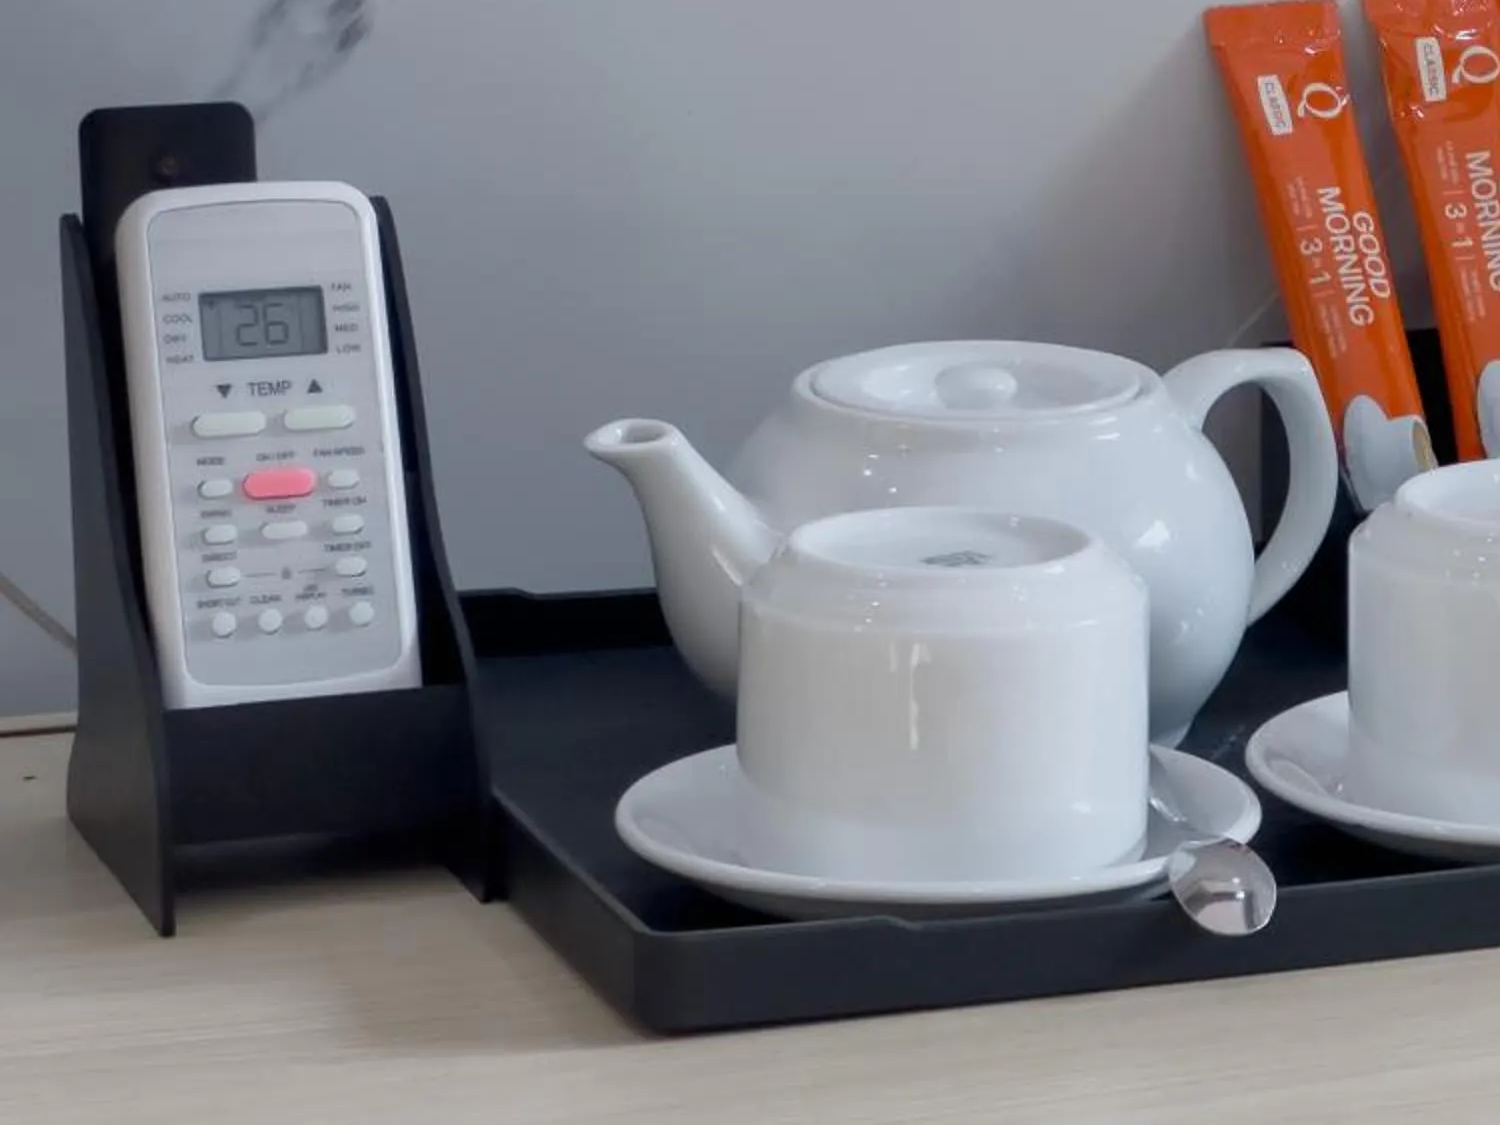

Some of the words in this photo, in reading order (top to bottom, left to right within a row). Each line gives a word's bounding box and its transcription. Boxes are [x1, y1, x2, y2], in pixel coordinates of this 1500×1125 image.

[1444, 202, 1468, 220] 3
[1300, 237, 1324, 256] 3
[1451, 236, 1474, 248] 1
[1316, 186, 1376, 327] MORNING
[1352, 210, 1392, 299] GOOD
[1309, 271, 1332, 285] 1
[161, 292, 191, 302] AUTO
[162, 314, 193, 325] COOL
[236, 302, 289, 347] 26
[247, 379, 292, 397] TEMP
